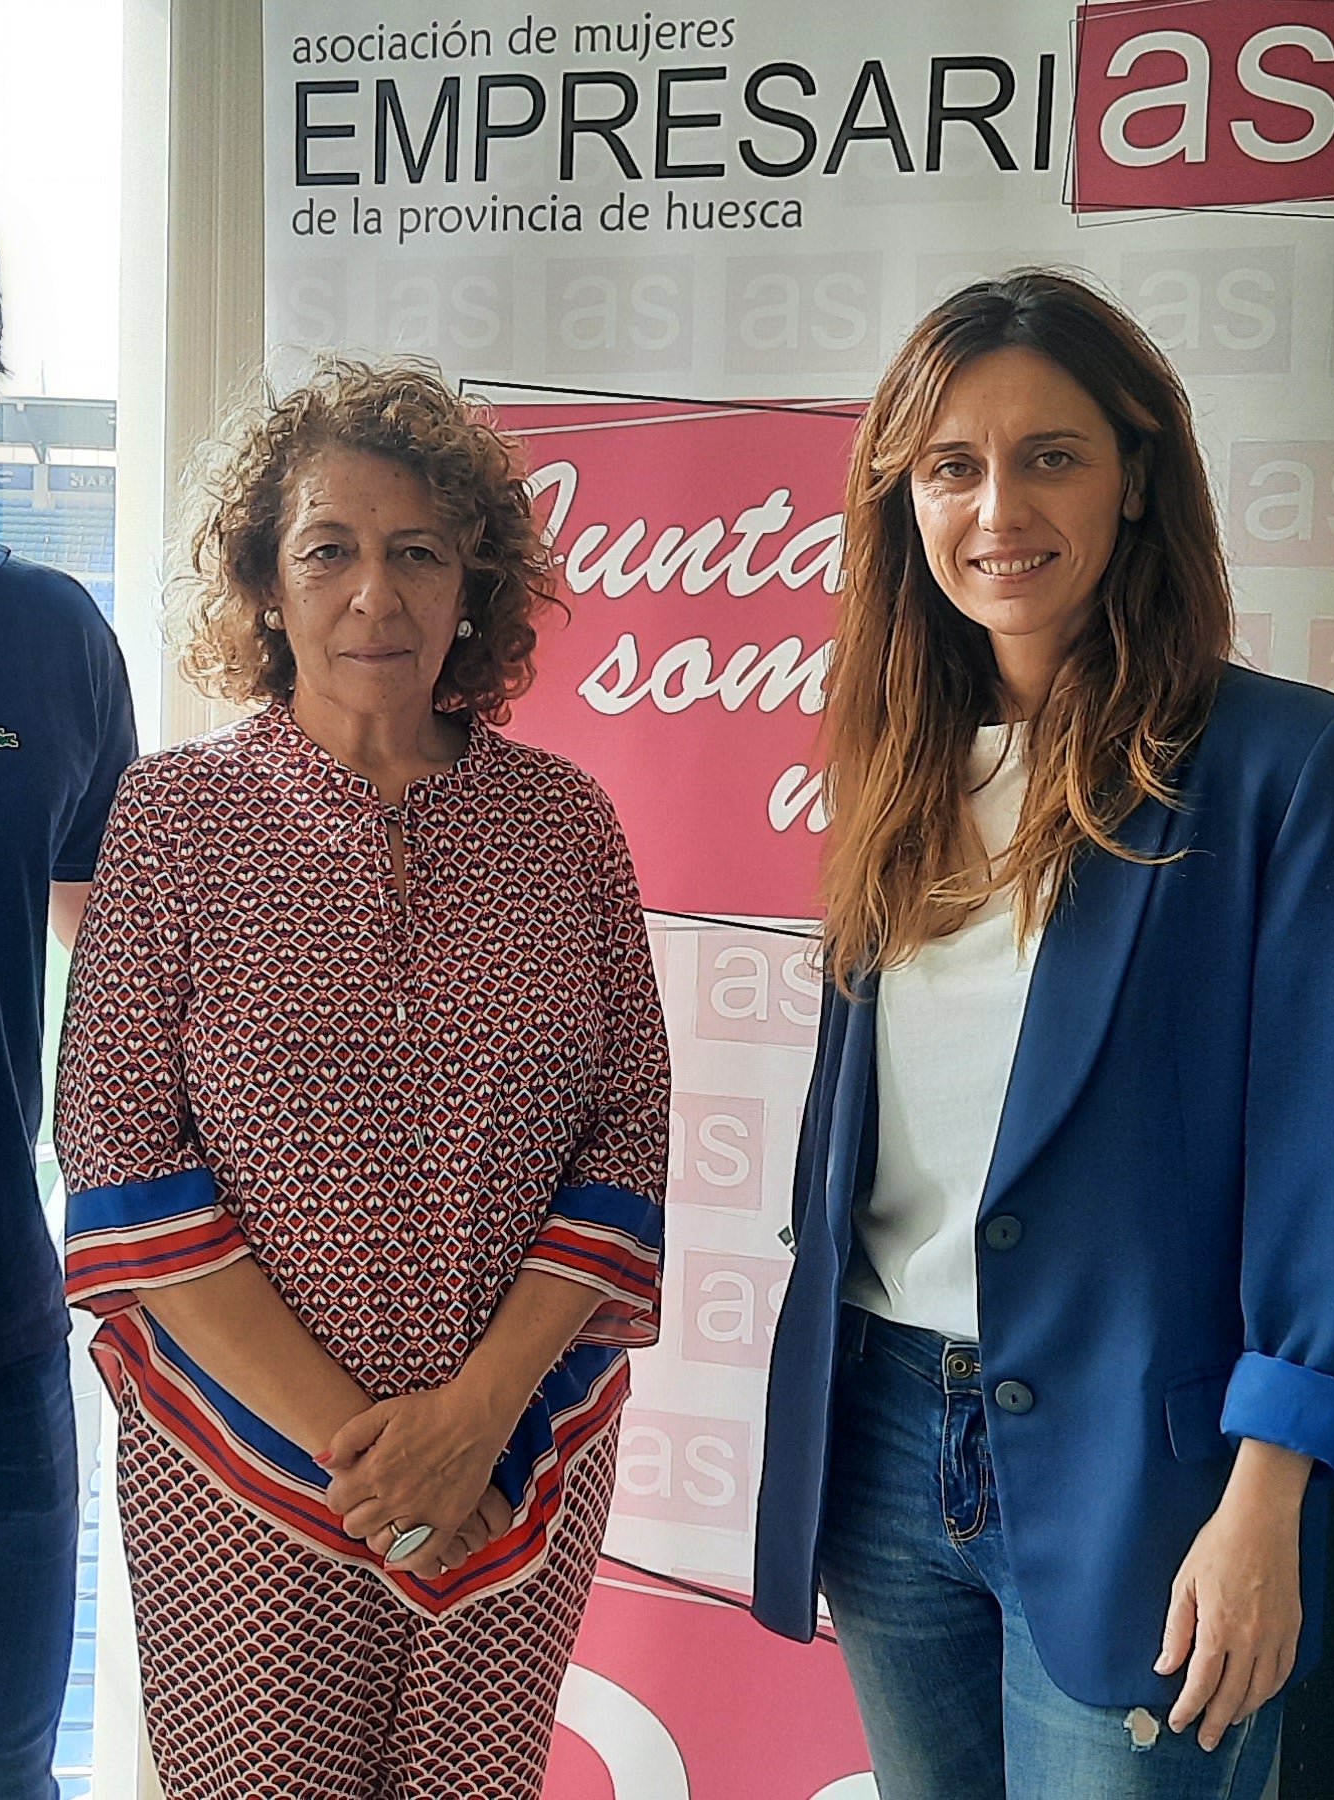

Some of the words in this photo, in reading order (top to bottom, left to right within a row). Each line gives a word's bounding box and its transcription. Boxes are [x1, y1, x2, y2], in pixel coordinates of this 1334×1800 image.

[292, 20, 492, 63] asociación
[508, 16, 556, 54] de
[574, 12, 735, 61] mujeres
[292, 198, 337, 235] de
[353, 197, 381, 234] la
[399, 194, 582, 244] provincia
[600, 193, 649, 231] de
[666, 191, 803, 230] huesca
[523, 460, 847, 599] Junta
